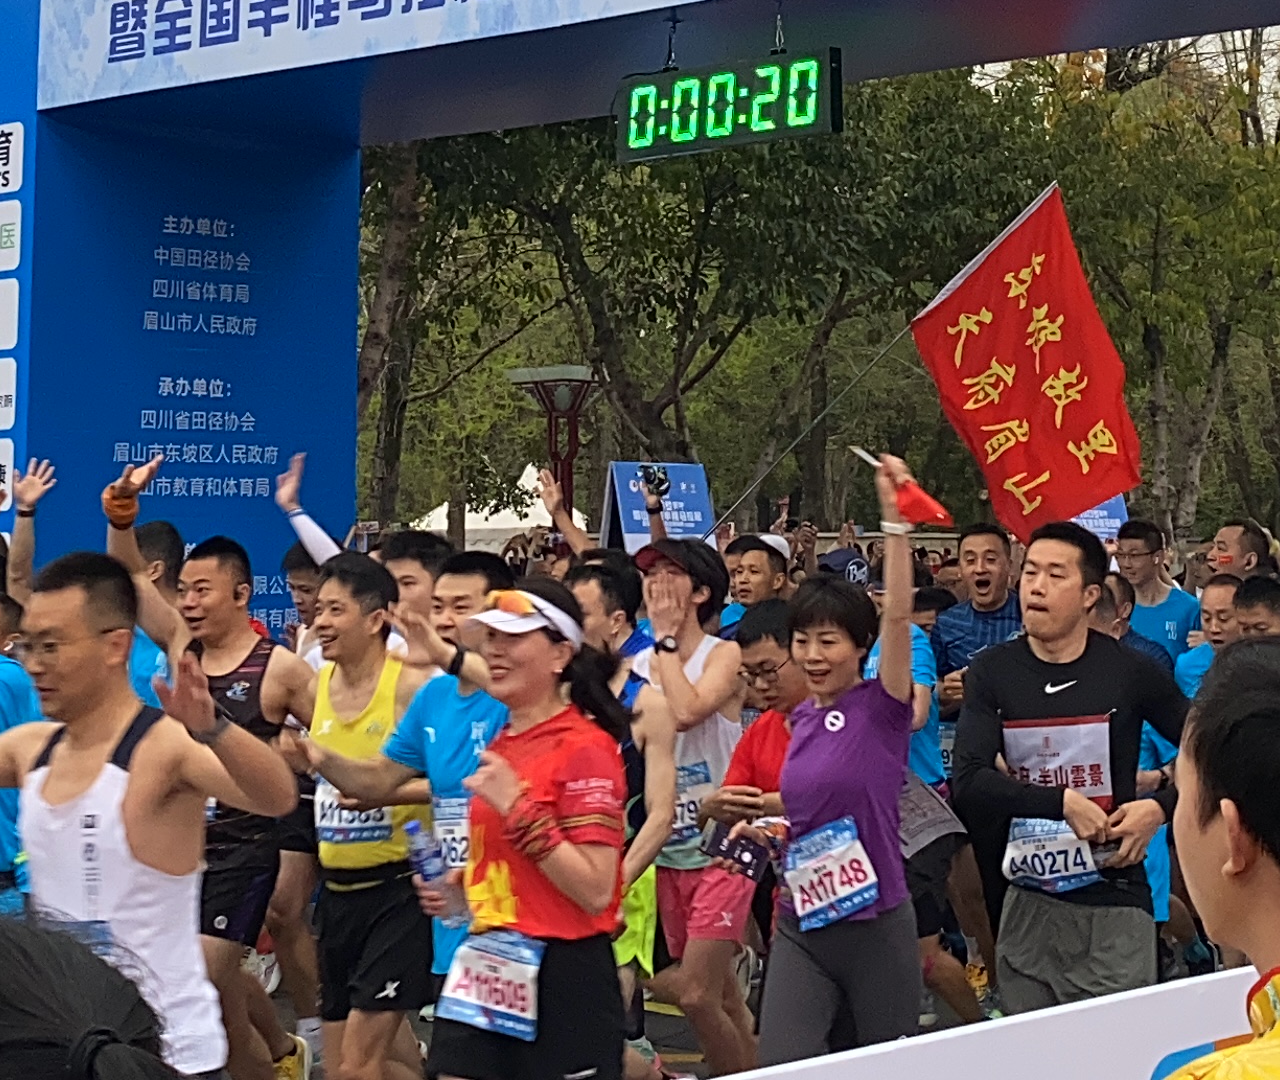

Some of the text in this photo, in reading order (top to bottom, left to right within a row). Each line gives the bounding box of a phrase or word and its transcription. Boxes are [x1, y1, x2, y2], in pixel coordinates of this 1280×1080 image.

[628, 60, 818, 149] 0:00:20
[153, 247, 251, 272] 中国田径协会
[152, 279, 250, 304] 四川省体育局
[142, 310, 257, 336] 眉山市人民政府
[140, 409, 256, 432] 四川省田径协会
[947, 306, 1051, 516] 天府眉山
[113, 441, 279, 466] 眉山市东坡区人民政府
[138, 476, 270, 499] 山市教育和体育局
[1010, 847, 1087, 877] A10274
[798, 858, 868, 911] A11748
